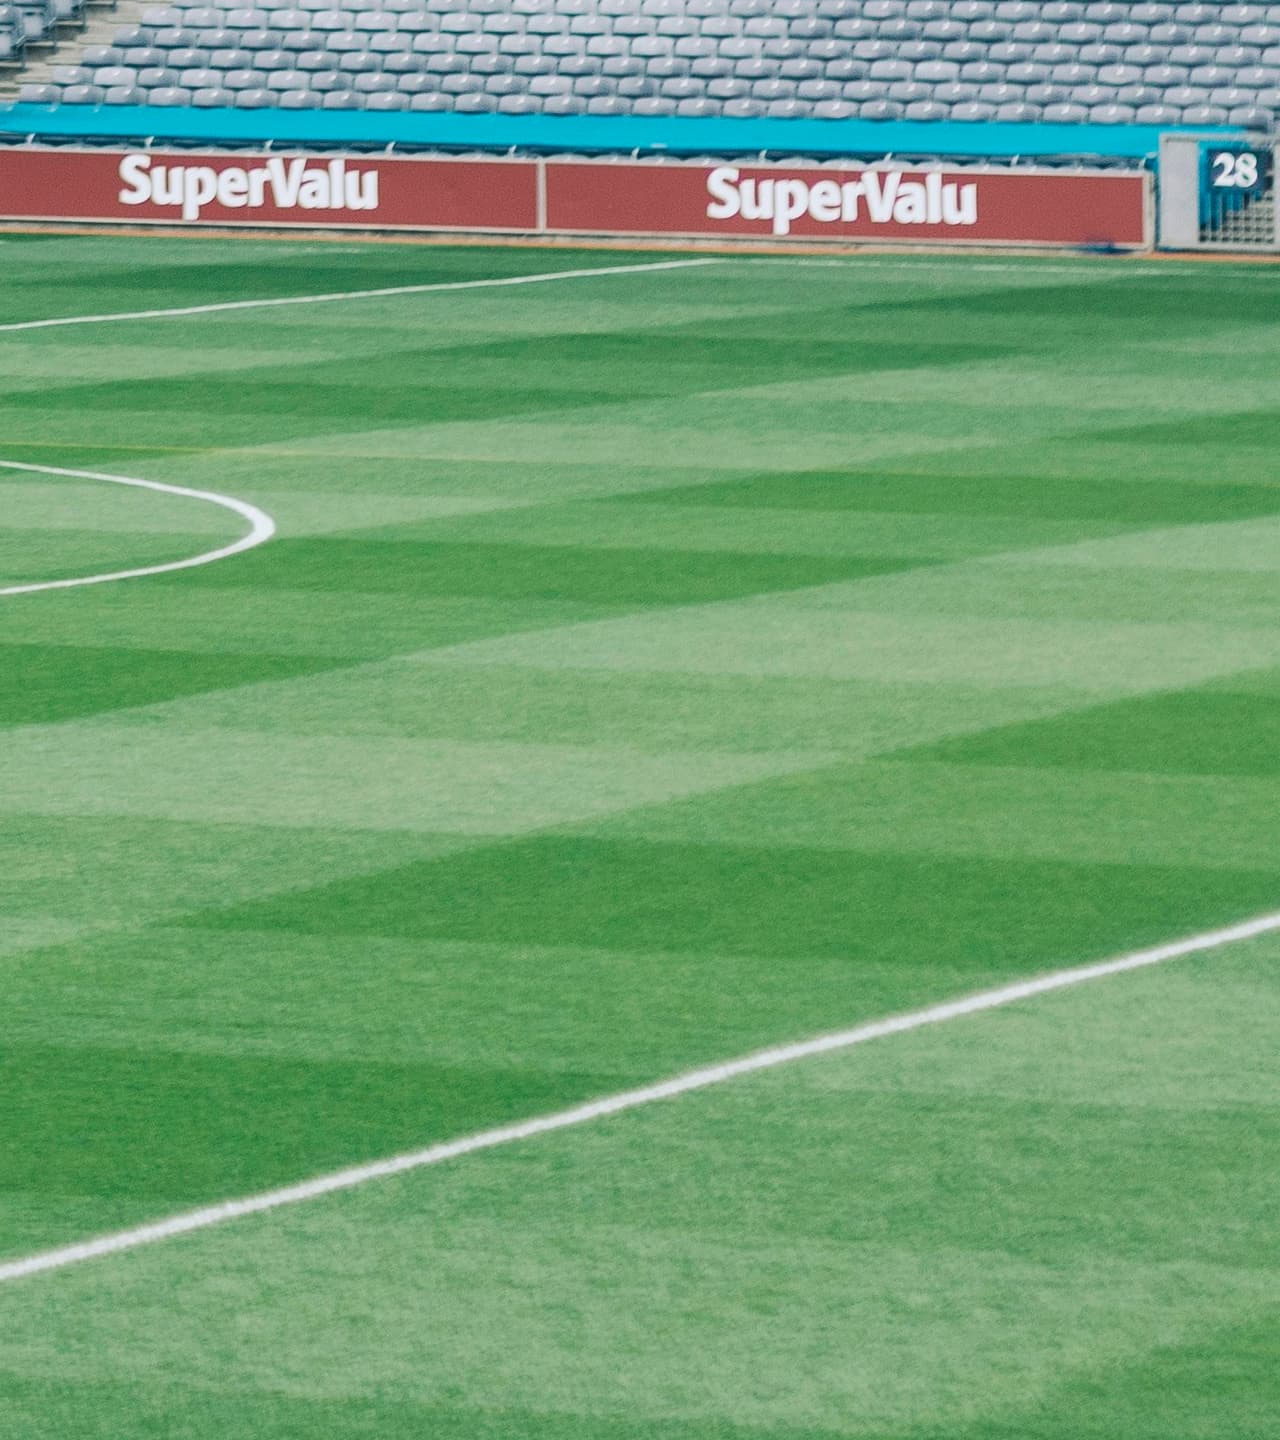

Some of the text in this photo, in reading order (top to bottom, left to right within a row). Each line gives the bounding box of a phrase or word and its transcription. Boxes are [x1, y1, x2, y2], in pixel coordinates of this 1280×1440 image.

[119, 154, 379, 220] SuperValu
[706, 167, 978, 235] SuperValu
[1212, 152, 1258, 188] 28
